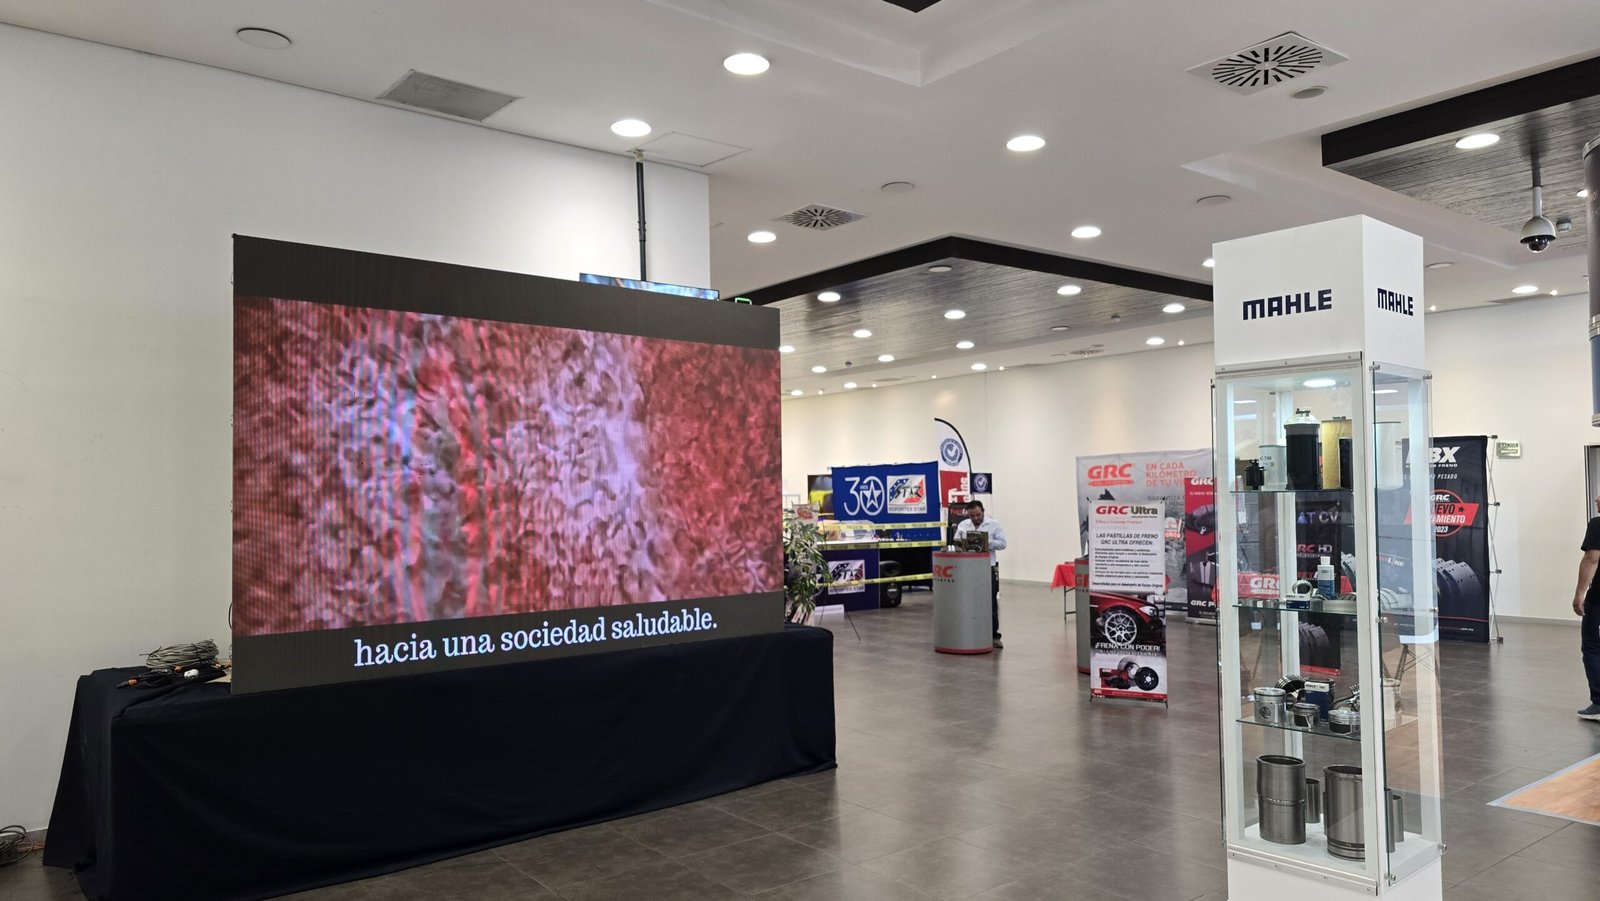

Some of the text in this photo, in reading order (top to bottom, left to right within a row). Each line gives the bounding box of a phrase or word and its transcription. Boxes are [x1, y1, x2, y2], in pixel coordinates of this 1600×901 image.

[1242, 288, 1332, 320] MAHLE
[1377, 287, 1414, 317] MAHLE
[1088, 463, 1132, 479] GRC
[1146, 462, 1184, 472] EN CADA
[1146, 469, 1197, 479] KILOMETRO
[843, 475, 885, 516] 30
[1095, 505, 1158, 515] GRC Ultra
[1297, 544, 1333, 553] RC HD
[354, 607, 718, 667] hacia una sociedad saludable.
